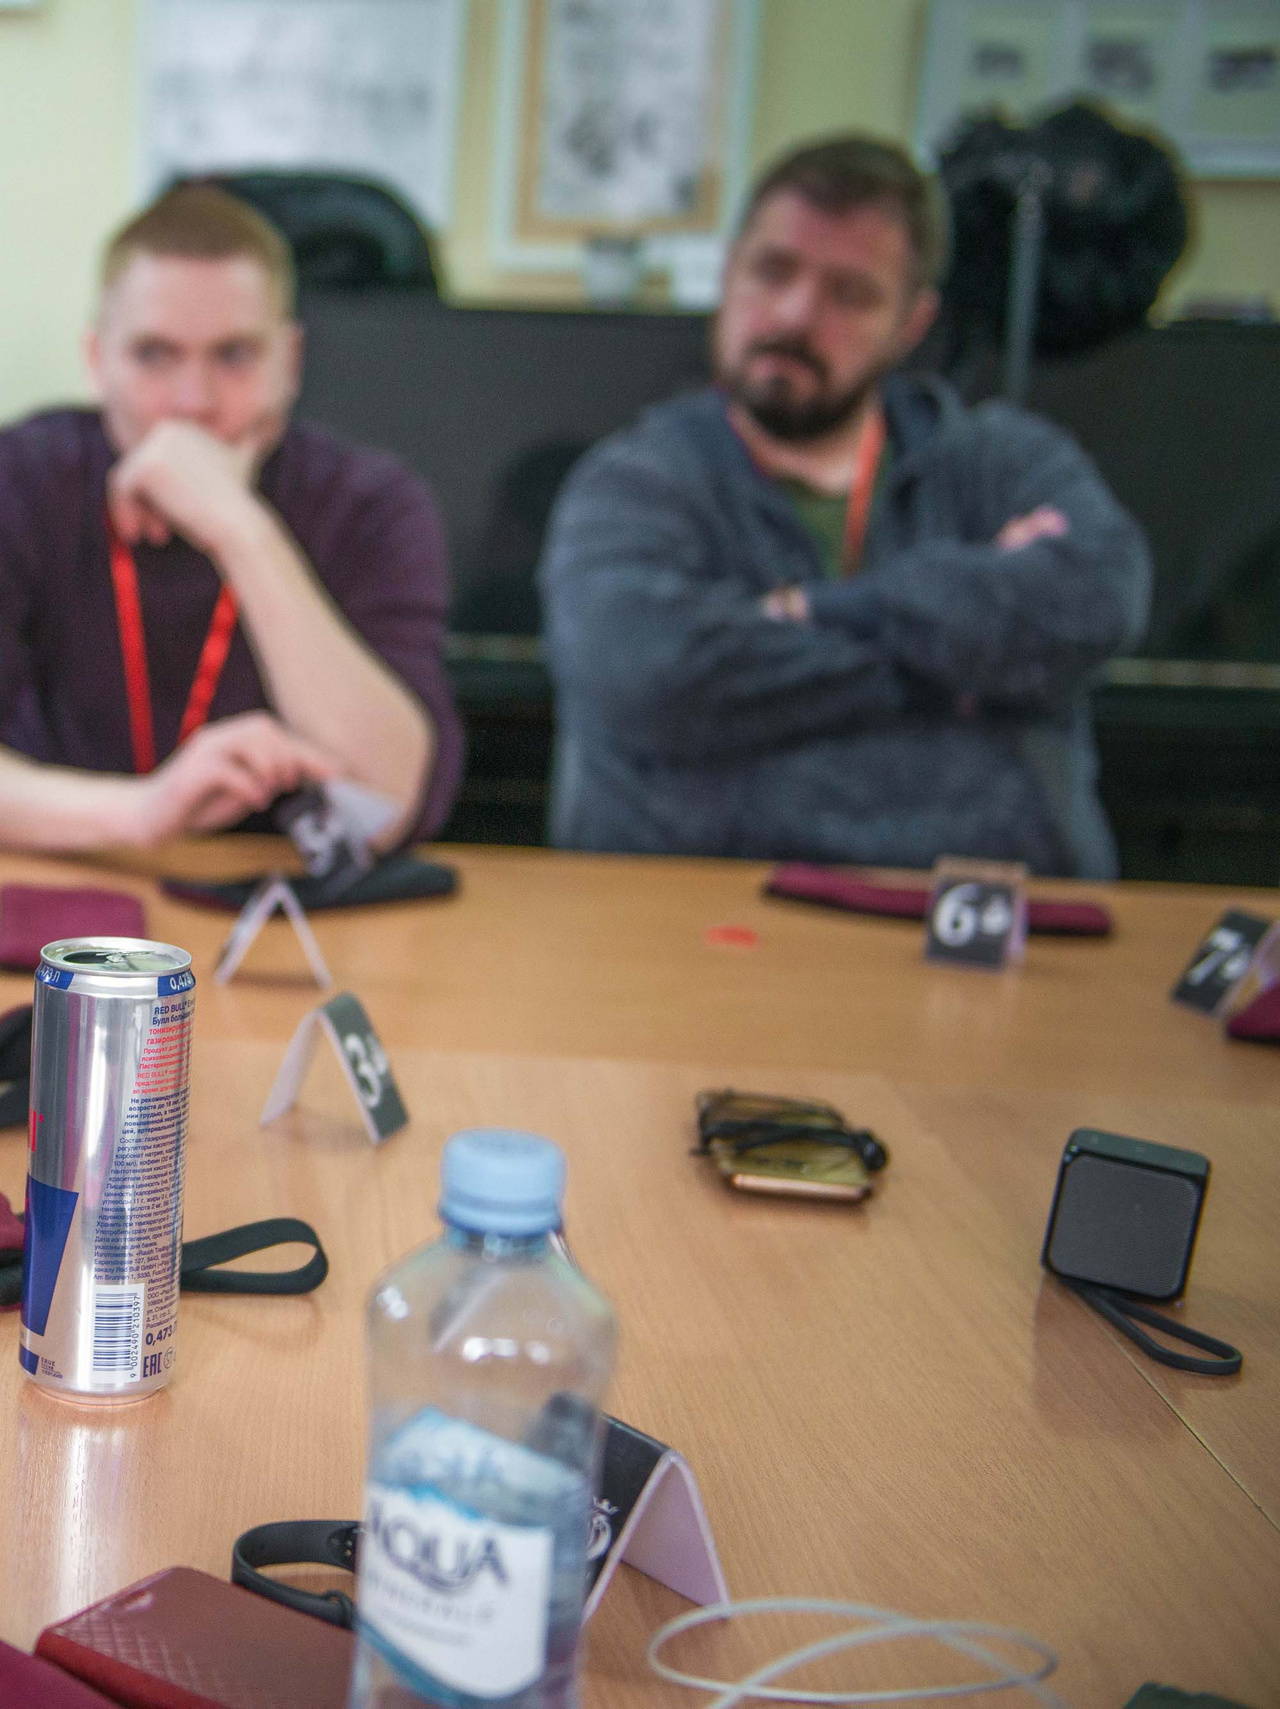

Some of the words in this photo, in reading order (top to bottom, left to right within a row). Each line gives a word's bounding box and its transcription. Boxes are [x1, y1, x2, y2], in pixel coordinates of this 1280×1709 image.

[932, 882, 978, 948] 6
[1188, 926, 1244, 986] 7
[153, 1016, 170, 1026] Булл
[155, 1006, 170, 1014] RED
[344, 1032, 382, 1108] 3
[125, 1117, 164, 1126] повышенной
[132, 1296, 141, 1328] 210397
[130, 1334, 139, 1366] 002490
[146, 1325, 173, 1346] 0,473
[143, 1352, 163, 1378] EAC
